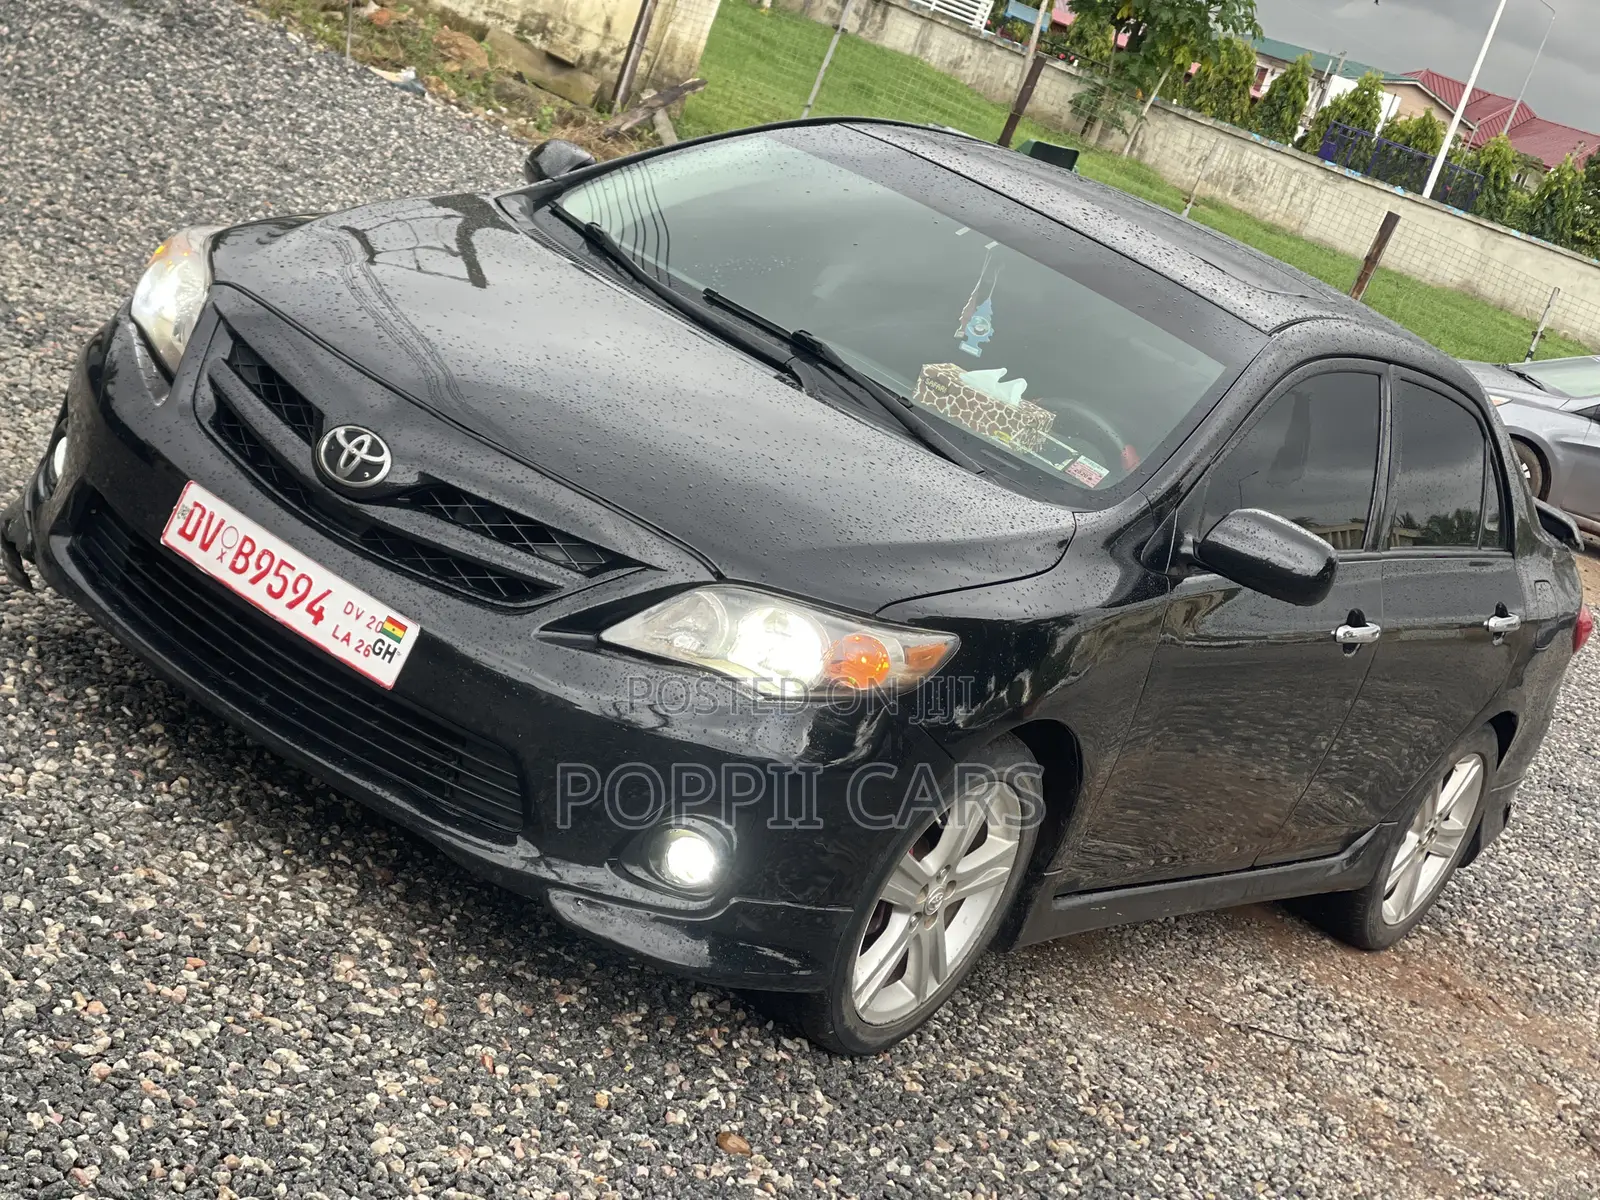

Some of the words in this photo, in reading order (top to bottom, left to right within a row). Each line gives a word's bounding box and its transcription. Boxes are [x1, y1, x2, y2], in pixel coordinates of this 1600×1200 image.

[924, 376, 948, 394] SAFARI
[177, 501, 226, 552] DV
[228, 535, 333, 626] B9594
[343, 601, 365, 621] DV
[332, 624, 351, 647] LA
[354, 639, 373, 658] 26
[372, 638, 398, 665] GH
